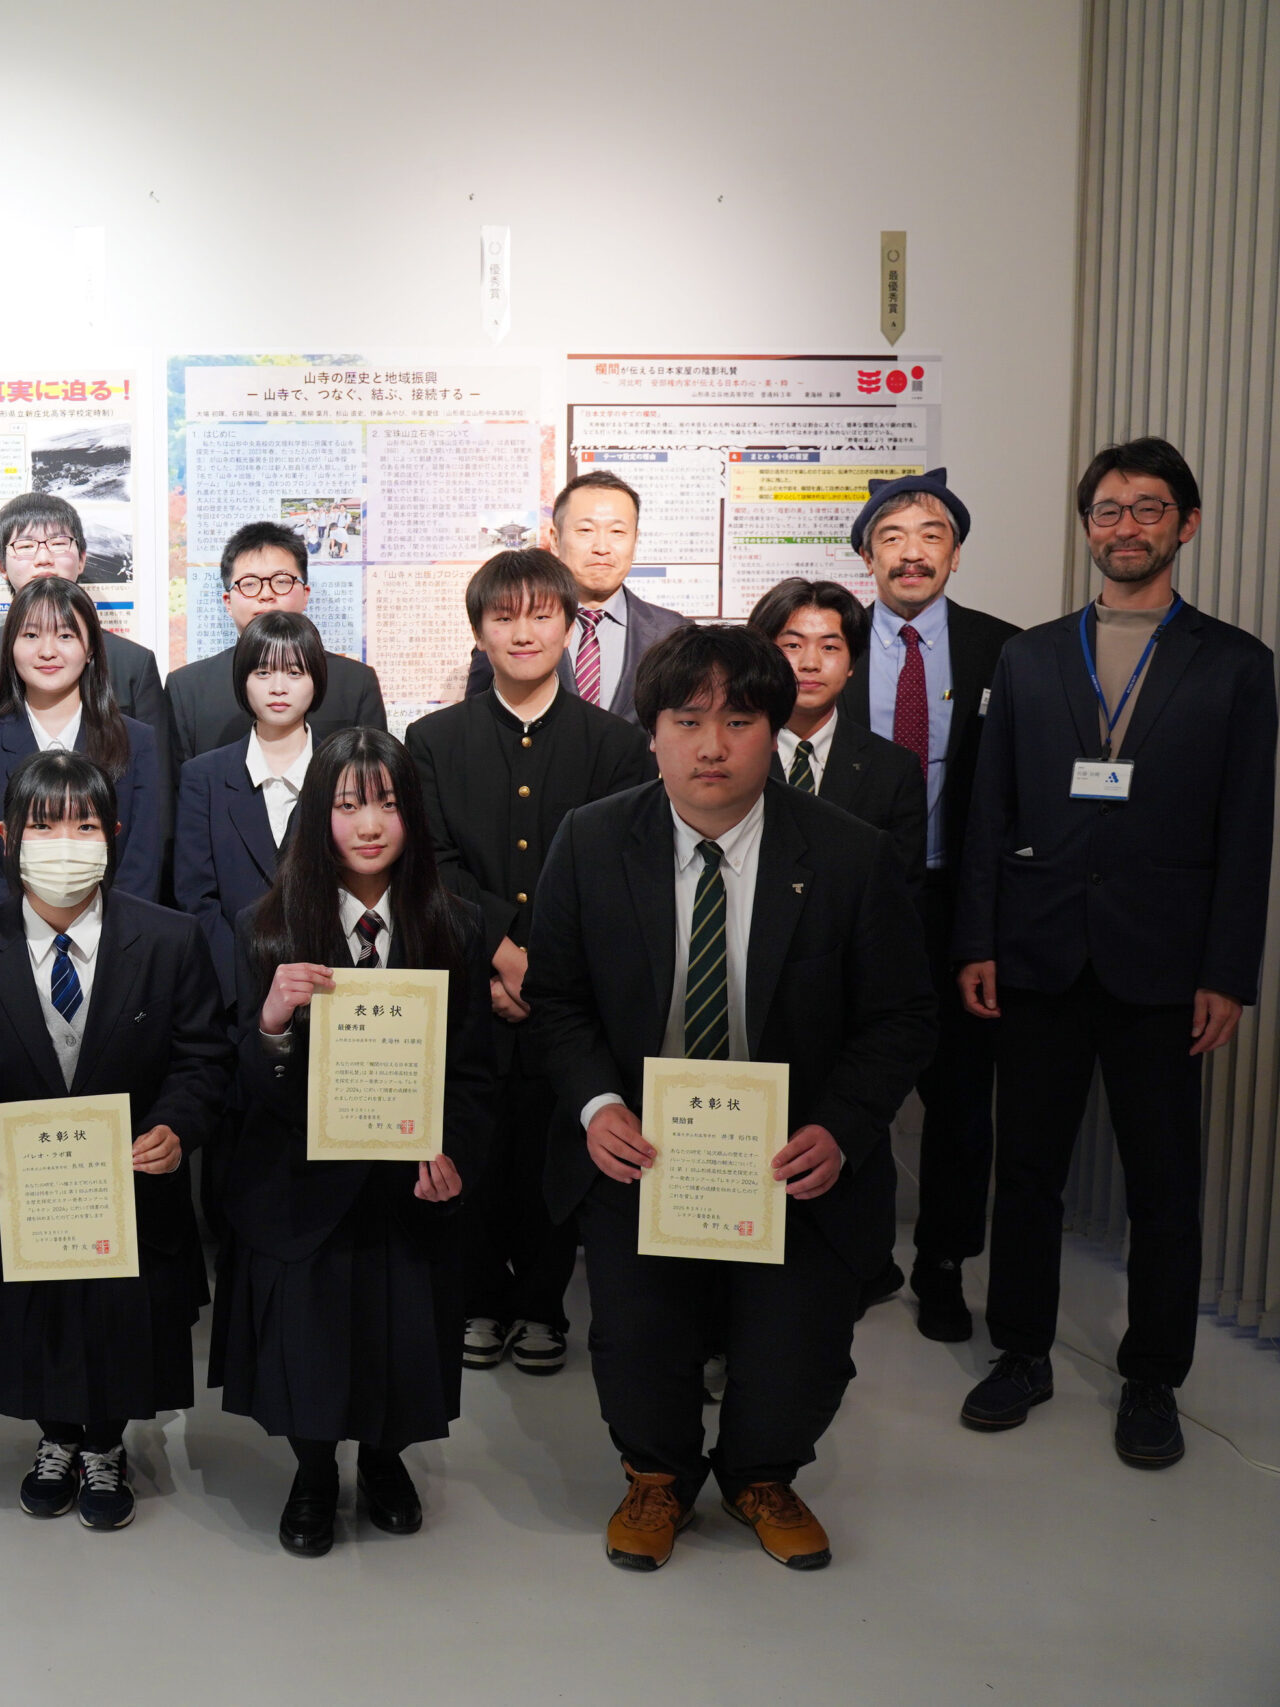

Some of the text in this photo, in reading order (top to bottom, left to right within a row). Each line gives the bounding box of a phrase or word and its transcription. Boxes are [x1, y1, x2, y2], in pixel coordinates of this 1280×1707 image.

[595, 362, 738, 376] 欄間が伝える日本家屋の陰影礼賛
[303, 371, 438, 385] 山寺の歴史と地域振興
[264, 387, 464, 402] 山寺で、つなぐ、結ぶ、接続する
[203, 430, 236, 438] はじめに
[383, 429, 469, 438] 宝珠山立石寺について
[354, 1004, 403, 1017] 表彰状
[689, 1096, 741, 1111] 表彰状
[38, 1129, 87, 1143] 表彰状
